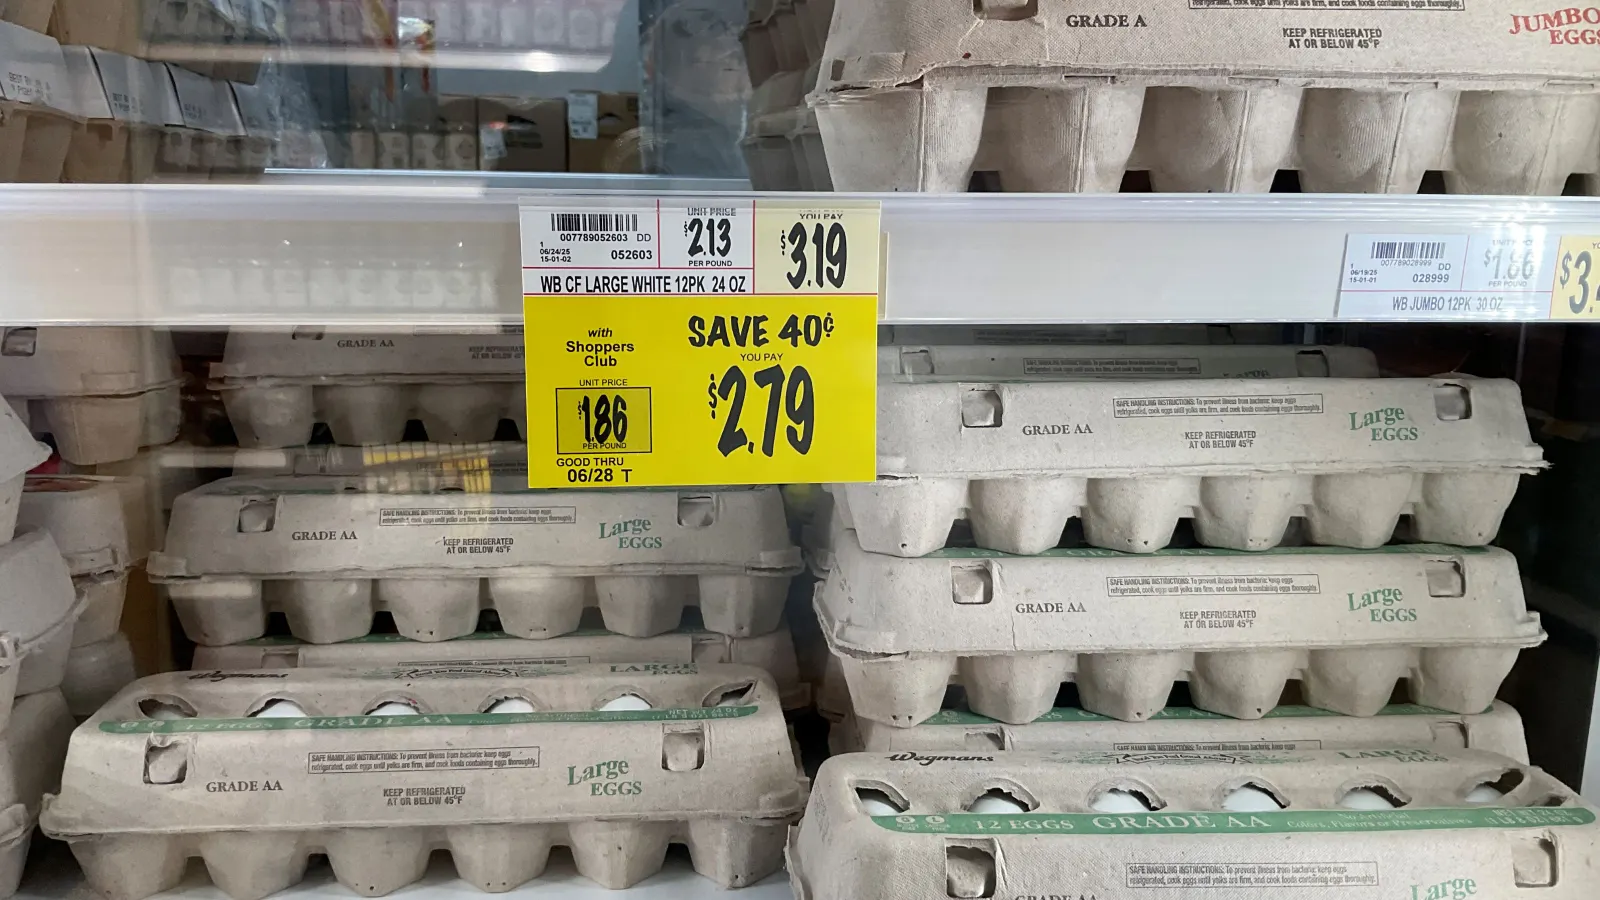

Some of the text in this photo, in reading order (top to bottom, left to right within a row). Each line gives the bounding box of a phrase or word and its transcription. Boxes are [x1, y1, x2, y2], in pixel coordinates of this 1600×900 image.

[1066, 14, 1148, 28] GRADE A
[1508, 7, 1600, 34] JUMBO
[1282, 28, 1382, 38] KEEP REFRIGERATED
[1288, 38, 1301, 48] AT
[1304, 38, 1318, 48] OR
[1320, 38, 1354, 48] BELOW
[687, 207, 736, 216] UNIT PRICE
[799, 210, 844, 220] YOU PAY
[560, 234, 652, 242] 007789052603 DD
[684, 218, 732, 257] $2.13
[611, 250, 652, 260] 052603
[780, 222, 848, 290] $3.19
[1438, 262, 1451, 271] DD
[541, 276, 746, 292] WB CF LARGE WHITE 12PK 24 OZ
[1412, 274, 1450, 284] 028999
[1392, 296, 1504, 311] WB JUMBO 12PK 30 OZ
[588, 326, 612, 338] with
[688, 314, 769, 348] SAVE
[337, 340, 395, 348] GRADE AA
[566, 340, 634, 354] Shoppers
[584, 354, 617, 368] Club
[740, 354, 784, 362] YOU PAY
[708, 364, 814, 458] $2.79
[1349, 406, 1404, 431] Large
[1022, 424, 1093, 437] GRADE AA
[1185, 430, 1256, 440] KEEP REFRIGERATED
[1371, 427, 1418, 441] EGGS
[1188, 440, 1198, 449] AT
[1200, 440, 1210, 449] OR
[1212, 440, 1236, 448] BELOW
[556, 458, 624, 468] GOOD THRU
[567, 469, 632, 482] 06/28 T
[598, 518, 652, 538] Large
[292, 531, 358, 541] GRADE AA
[444, 537, 514, 546] KEEP REFRIGERATED
[619, 536, 662, 549] EGGS
[446, 546, 456, 554] AT
[458, 546, 468, 554] OR
[470, 545, 494, 554] BELOW
[1348, 588, 1404, 612] Large
[1016, 602, 1086, 614] GRADE AA
[1180, 610, 1256, 620] KEEP REFRIGERATED
[1370, 608, 1418, 622] EGGS
[1184, 620, 1194, 629] AT
[1196, 620, 1206, 629] OR
[1208, 619, 1234, 628] BELOW
[412, 716, 453, 724] AA
[884, 752, 994, 766] Wegmans
[567, 760, 628, 786] Large
[206, 780, 283, 792] GRADE AA
[384, 786, 466, 796] KEEP REFRIGERATED
[590, 780, 642, 796] EGGS
[400, 798, 411, 806] OR
[414, 796, 441, 805] BELOW
[444, 795, 462, 804] 45°F
[973, 815, 1272, 830] 12 EGGS GRADE AA
